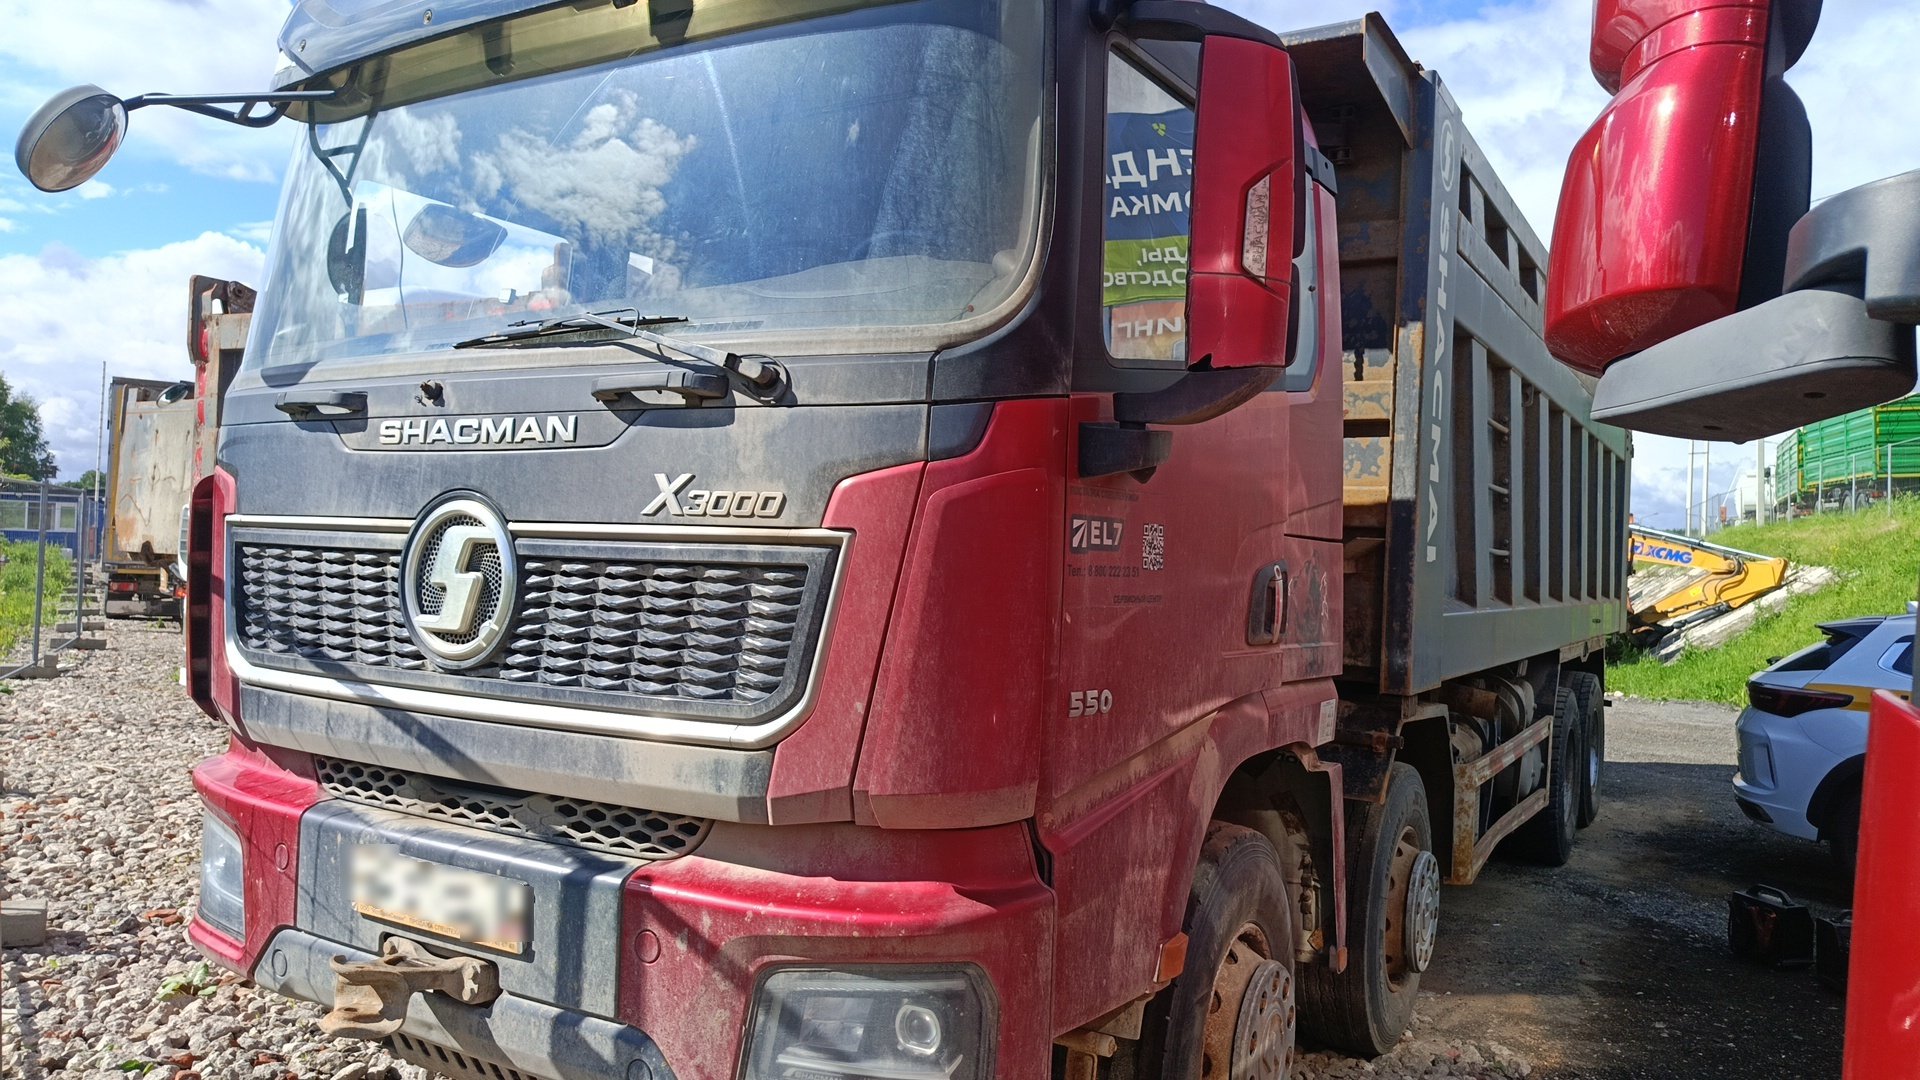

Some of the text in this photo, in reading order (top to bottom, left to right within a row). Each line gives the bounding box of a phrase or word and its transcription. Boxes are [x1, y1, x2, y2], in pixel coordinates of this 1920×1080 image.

[379, 415, 577, 444] SHACMAN
[640, 473, 786, 518] X3000
[1645, 545, 1693, 564] XCMG
[1069, 689, 1113, 717] 550
